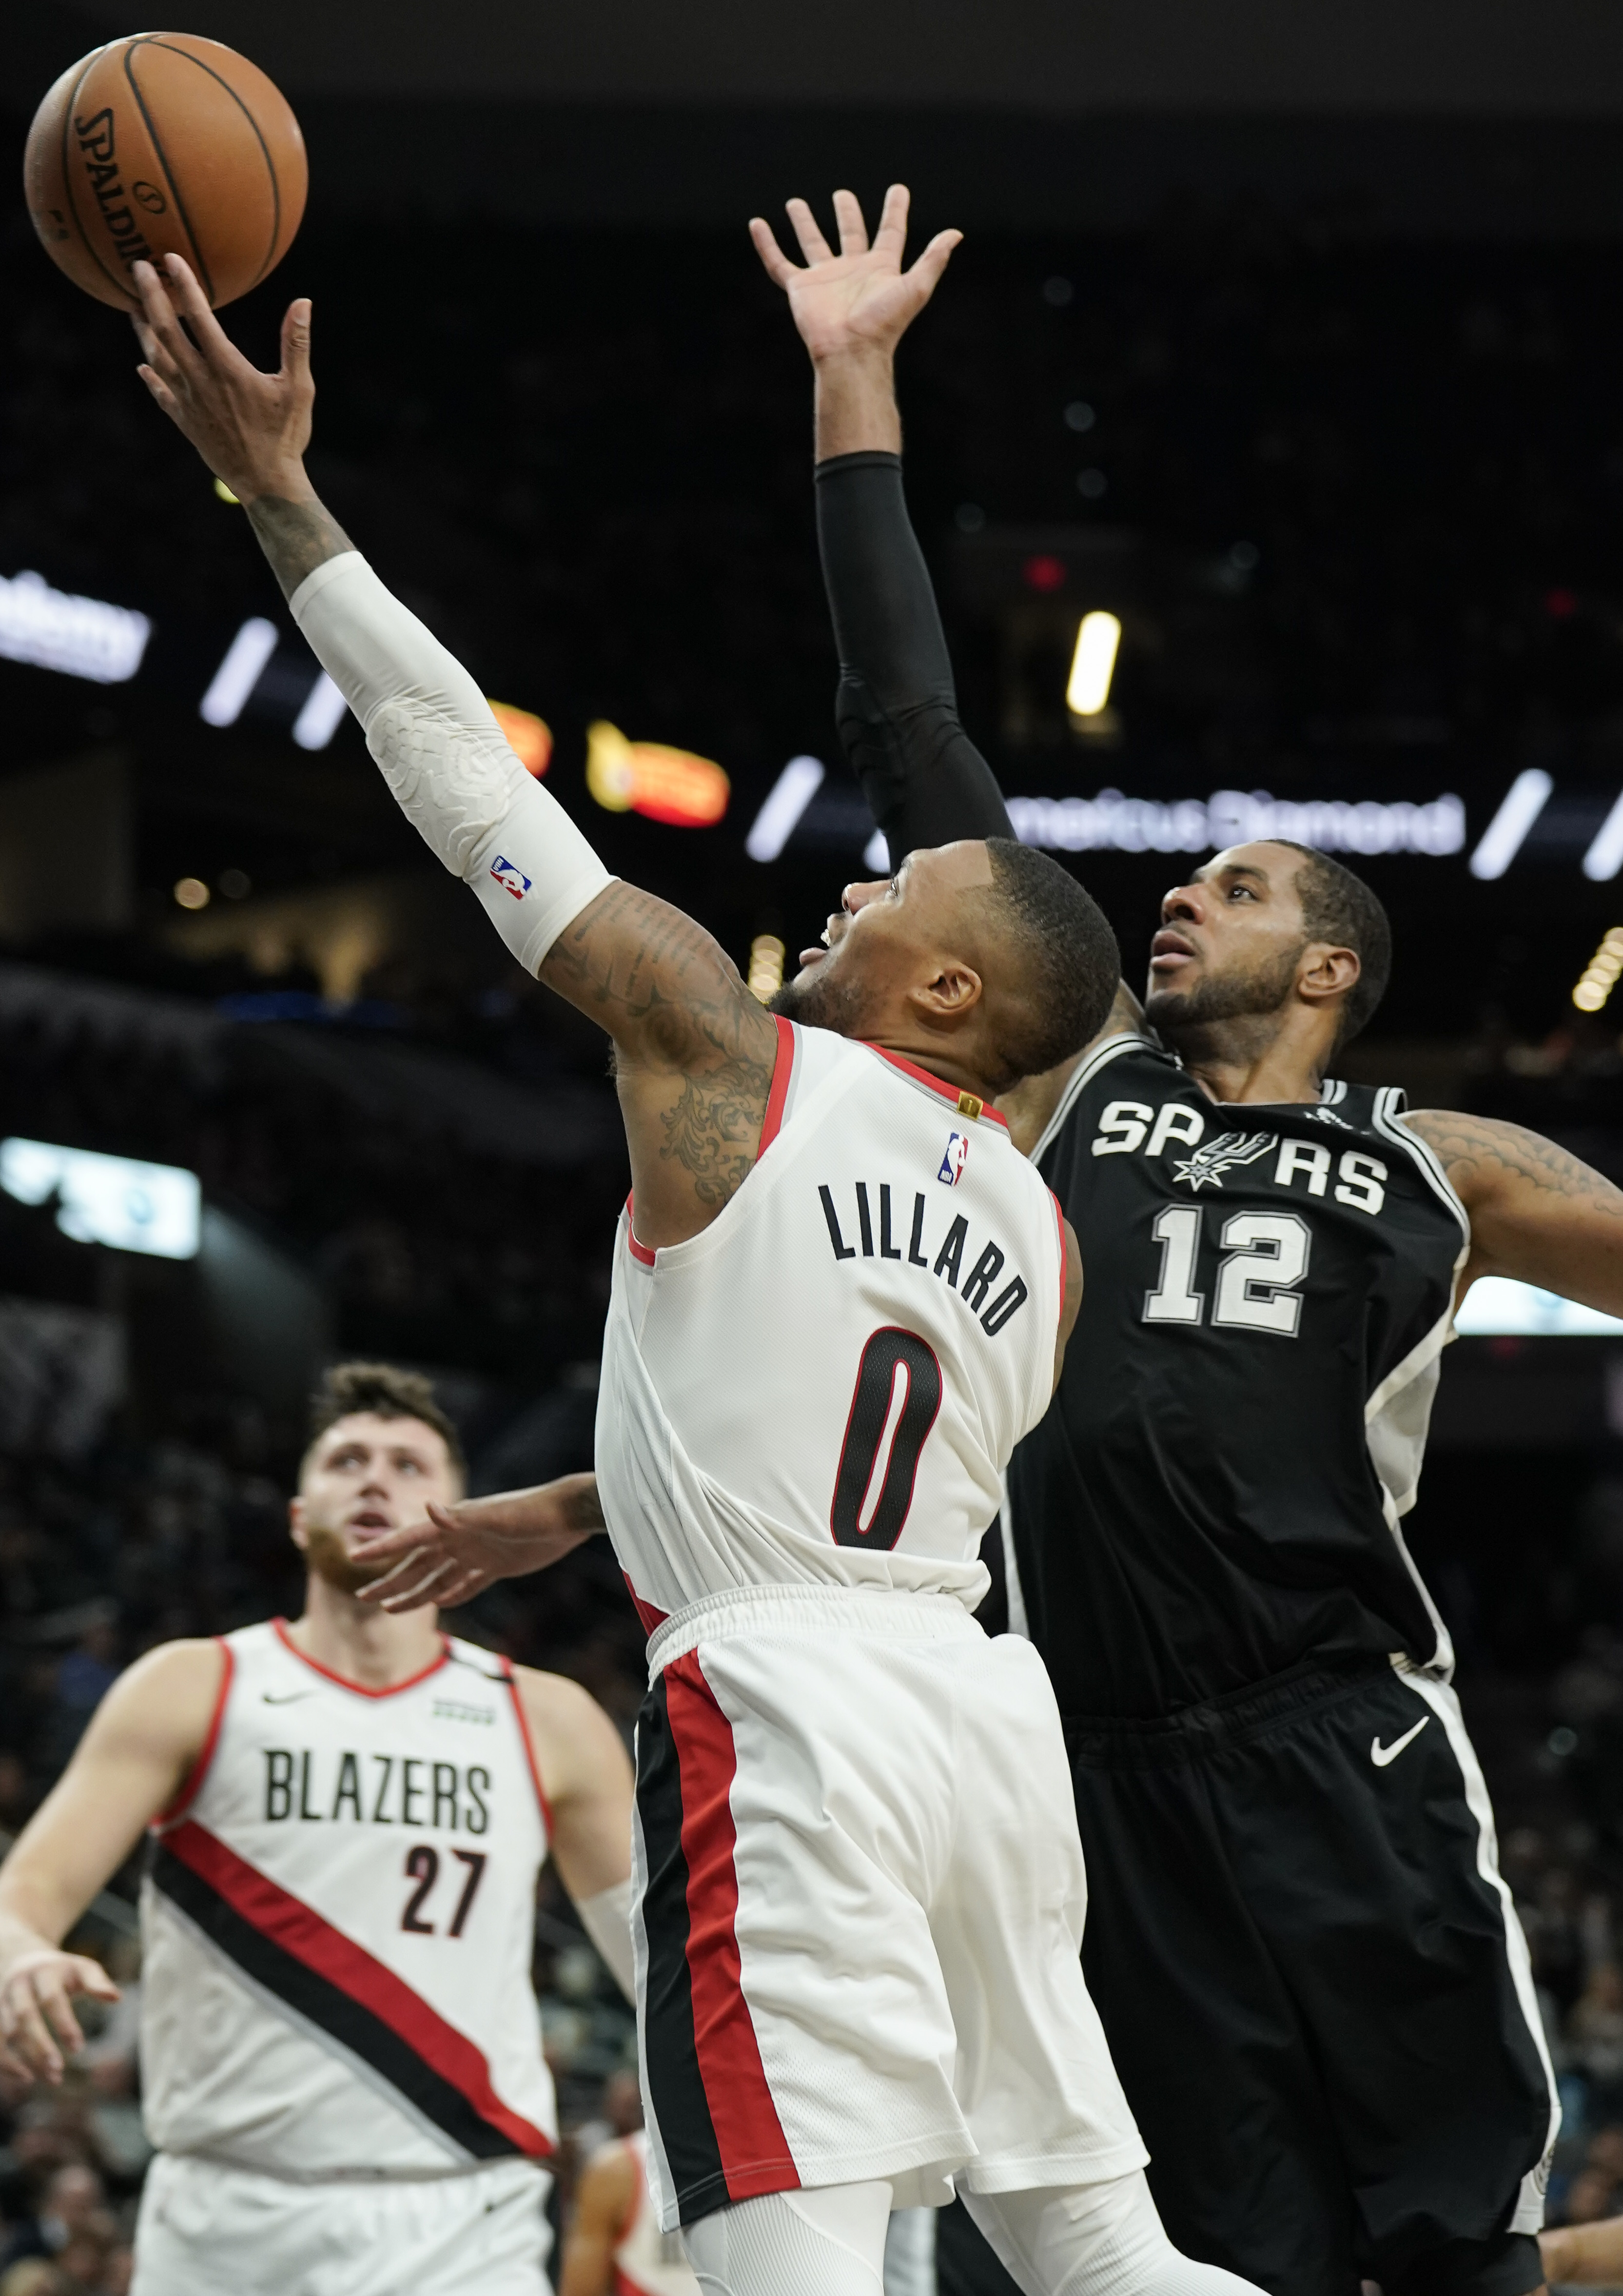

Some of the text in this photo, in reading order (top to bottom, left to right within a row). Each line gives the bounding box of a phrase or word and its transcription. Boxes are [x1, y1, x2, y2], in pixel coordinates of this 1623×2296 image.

[818, 1182, 1028, 1336] LILLARD
[1141, 1203, 1313, 1338] 12
[830, 1326, 942, 1551] 0
[264, 1748, 491, 1835] BLAZERS
[401, 1844, 489, 1938] 27
